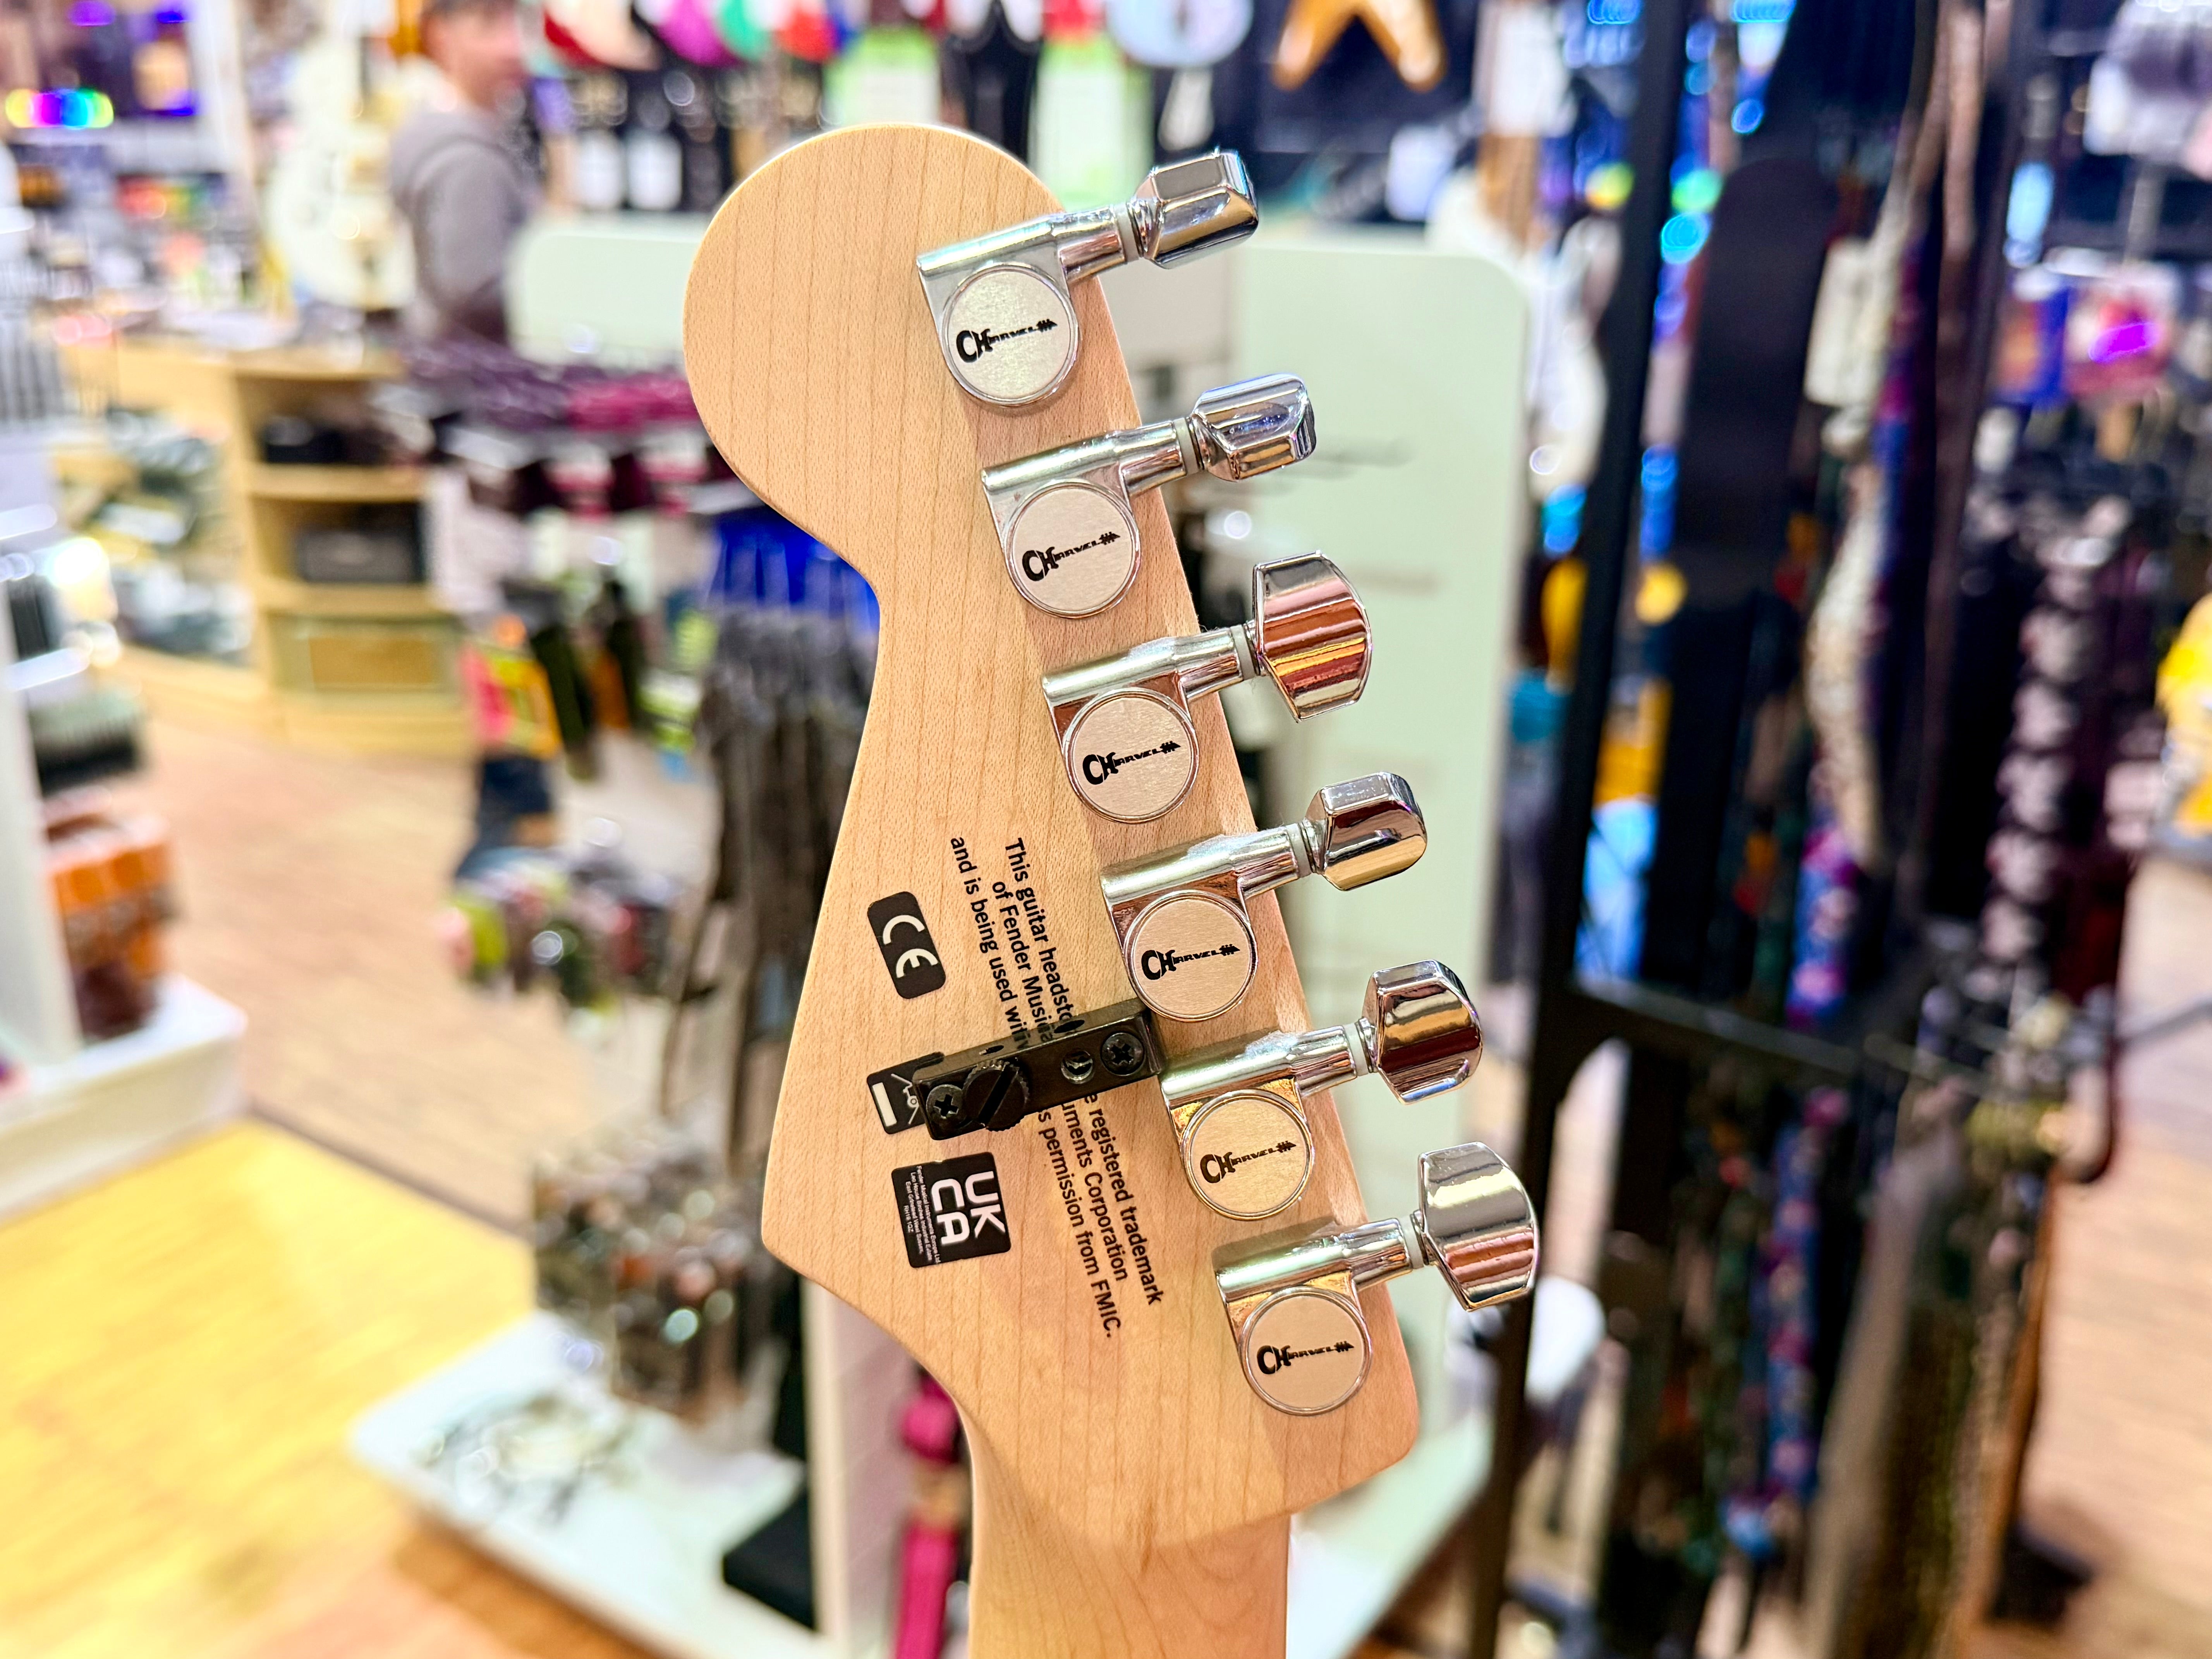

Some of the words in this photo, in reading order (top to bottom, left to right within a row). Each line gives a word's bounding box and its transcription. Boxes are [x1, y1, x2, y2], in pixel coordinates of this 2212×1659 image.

[951, 837, 977, 874] and
[1005, 838, 1030, 882] This
[964, 878, 981, 895] is
[992, 882, 1013, 900] of
[970, 899, 999, 953] being
[1000, 905, 1031, 970] Fender
[1016, 887, 1049, 942] guitar
[883, 915, 938, 978] CE
[989, 957, 1018, 1002] used
[1022, 975, 1052, 1027] Musi
[1039, 947, 1074, 1020] headsto
[1039, 1127, 1084, 1227] permission
[1089, 1108, 1134, 1202] registered
[1076, 1230, 1099, 1275] from
[1084, 1172, 1128, 1281] Corporation
[1120, 1206, 1164, 1305] trademark
[1091, 1278, 1121, 1338] FMIC.
